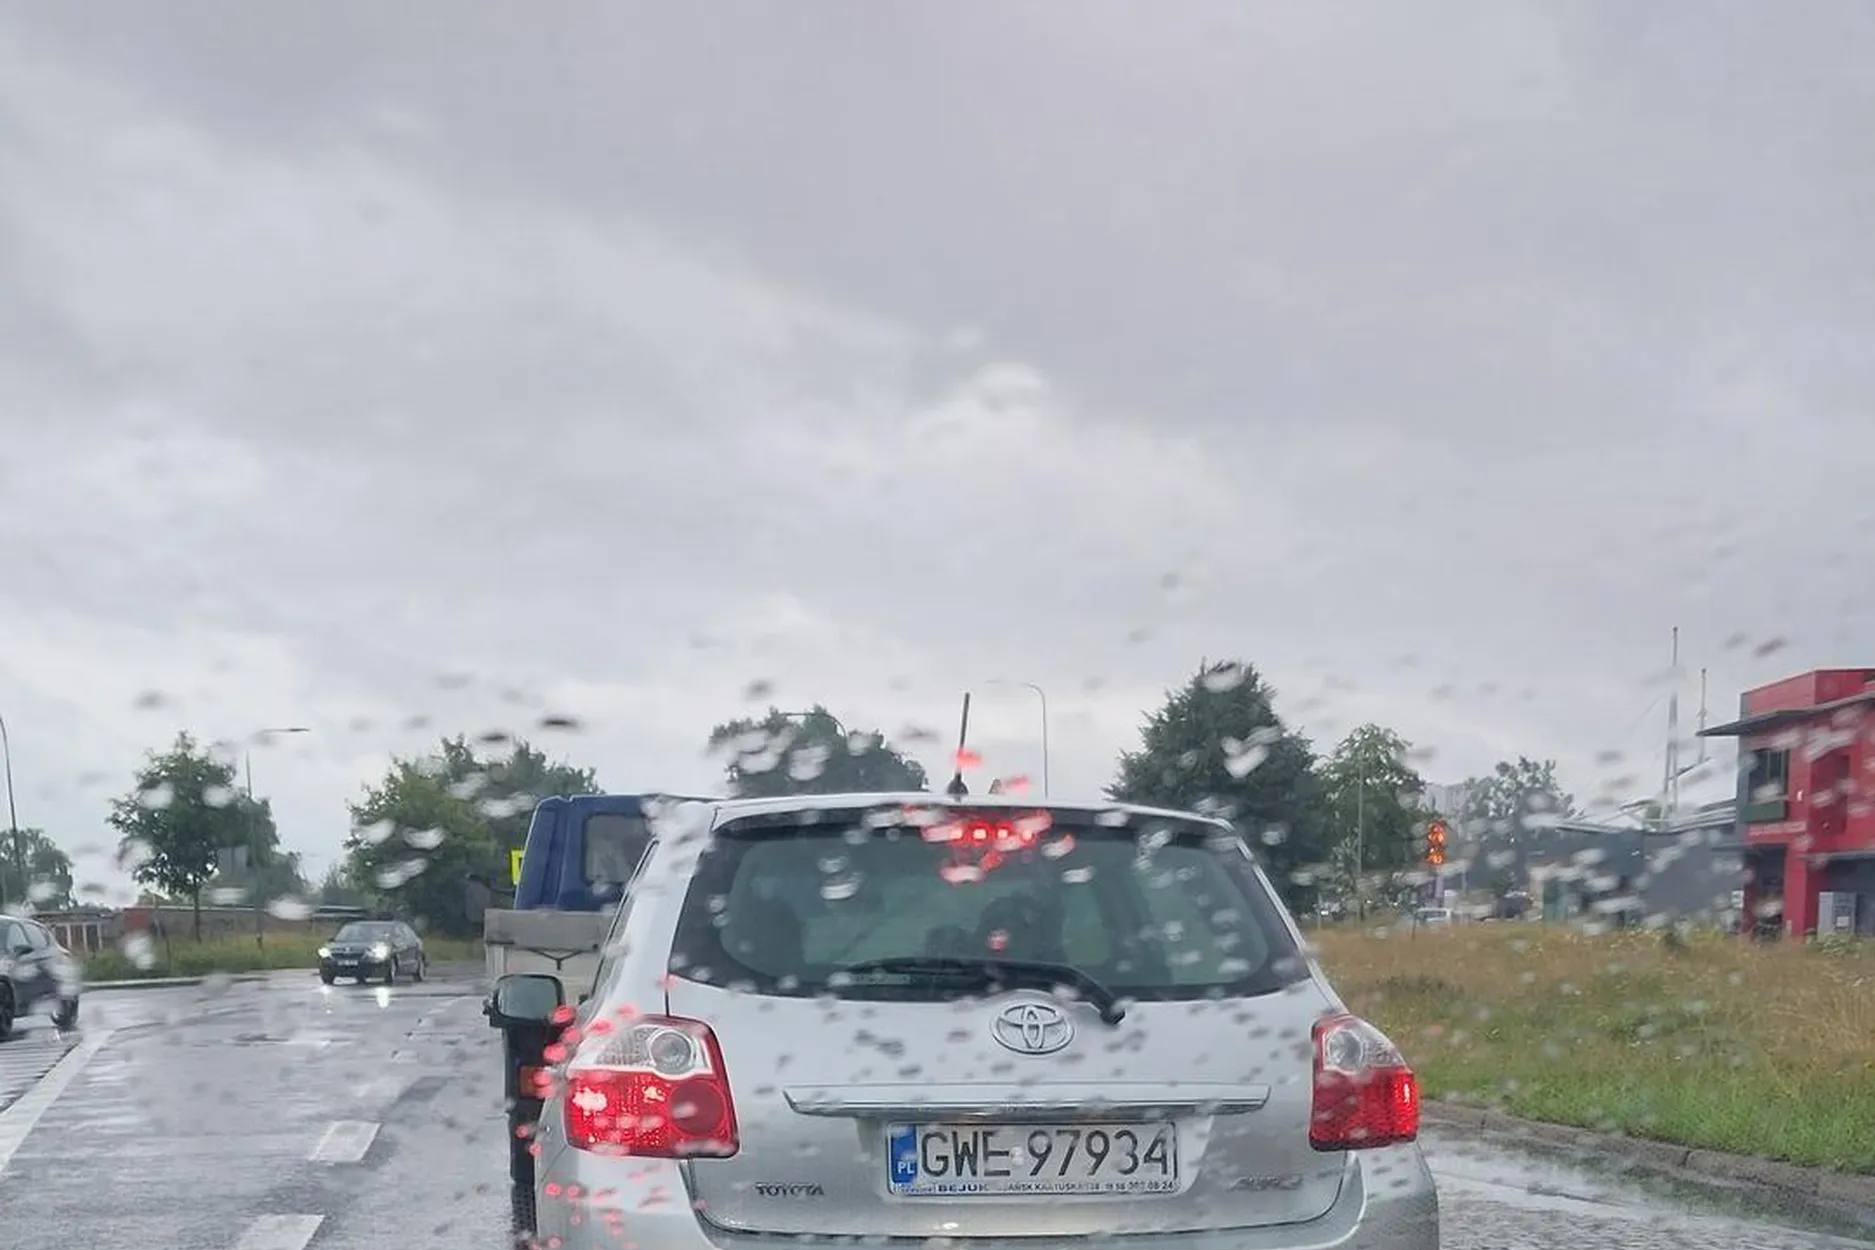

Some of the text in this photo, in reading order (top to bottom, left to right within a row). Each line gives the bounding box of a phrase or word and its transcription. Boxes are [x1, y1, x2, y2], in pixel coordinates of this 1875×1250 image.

[921, 1129, 1169, 1177] GWE 97934
[897, 1161, 916, 1175] PL
[755, 1182, 824, 1196] TOYOTA
